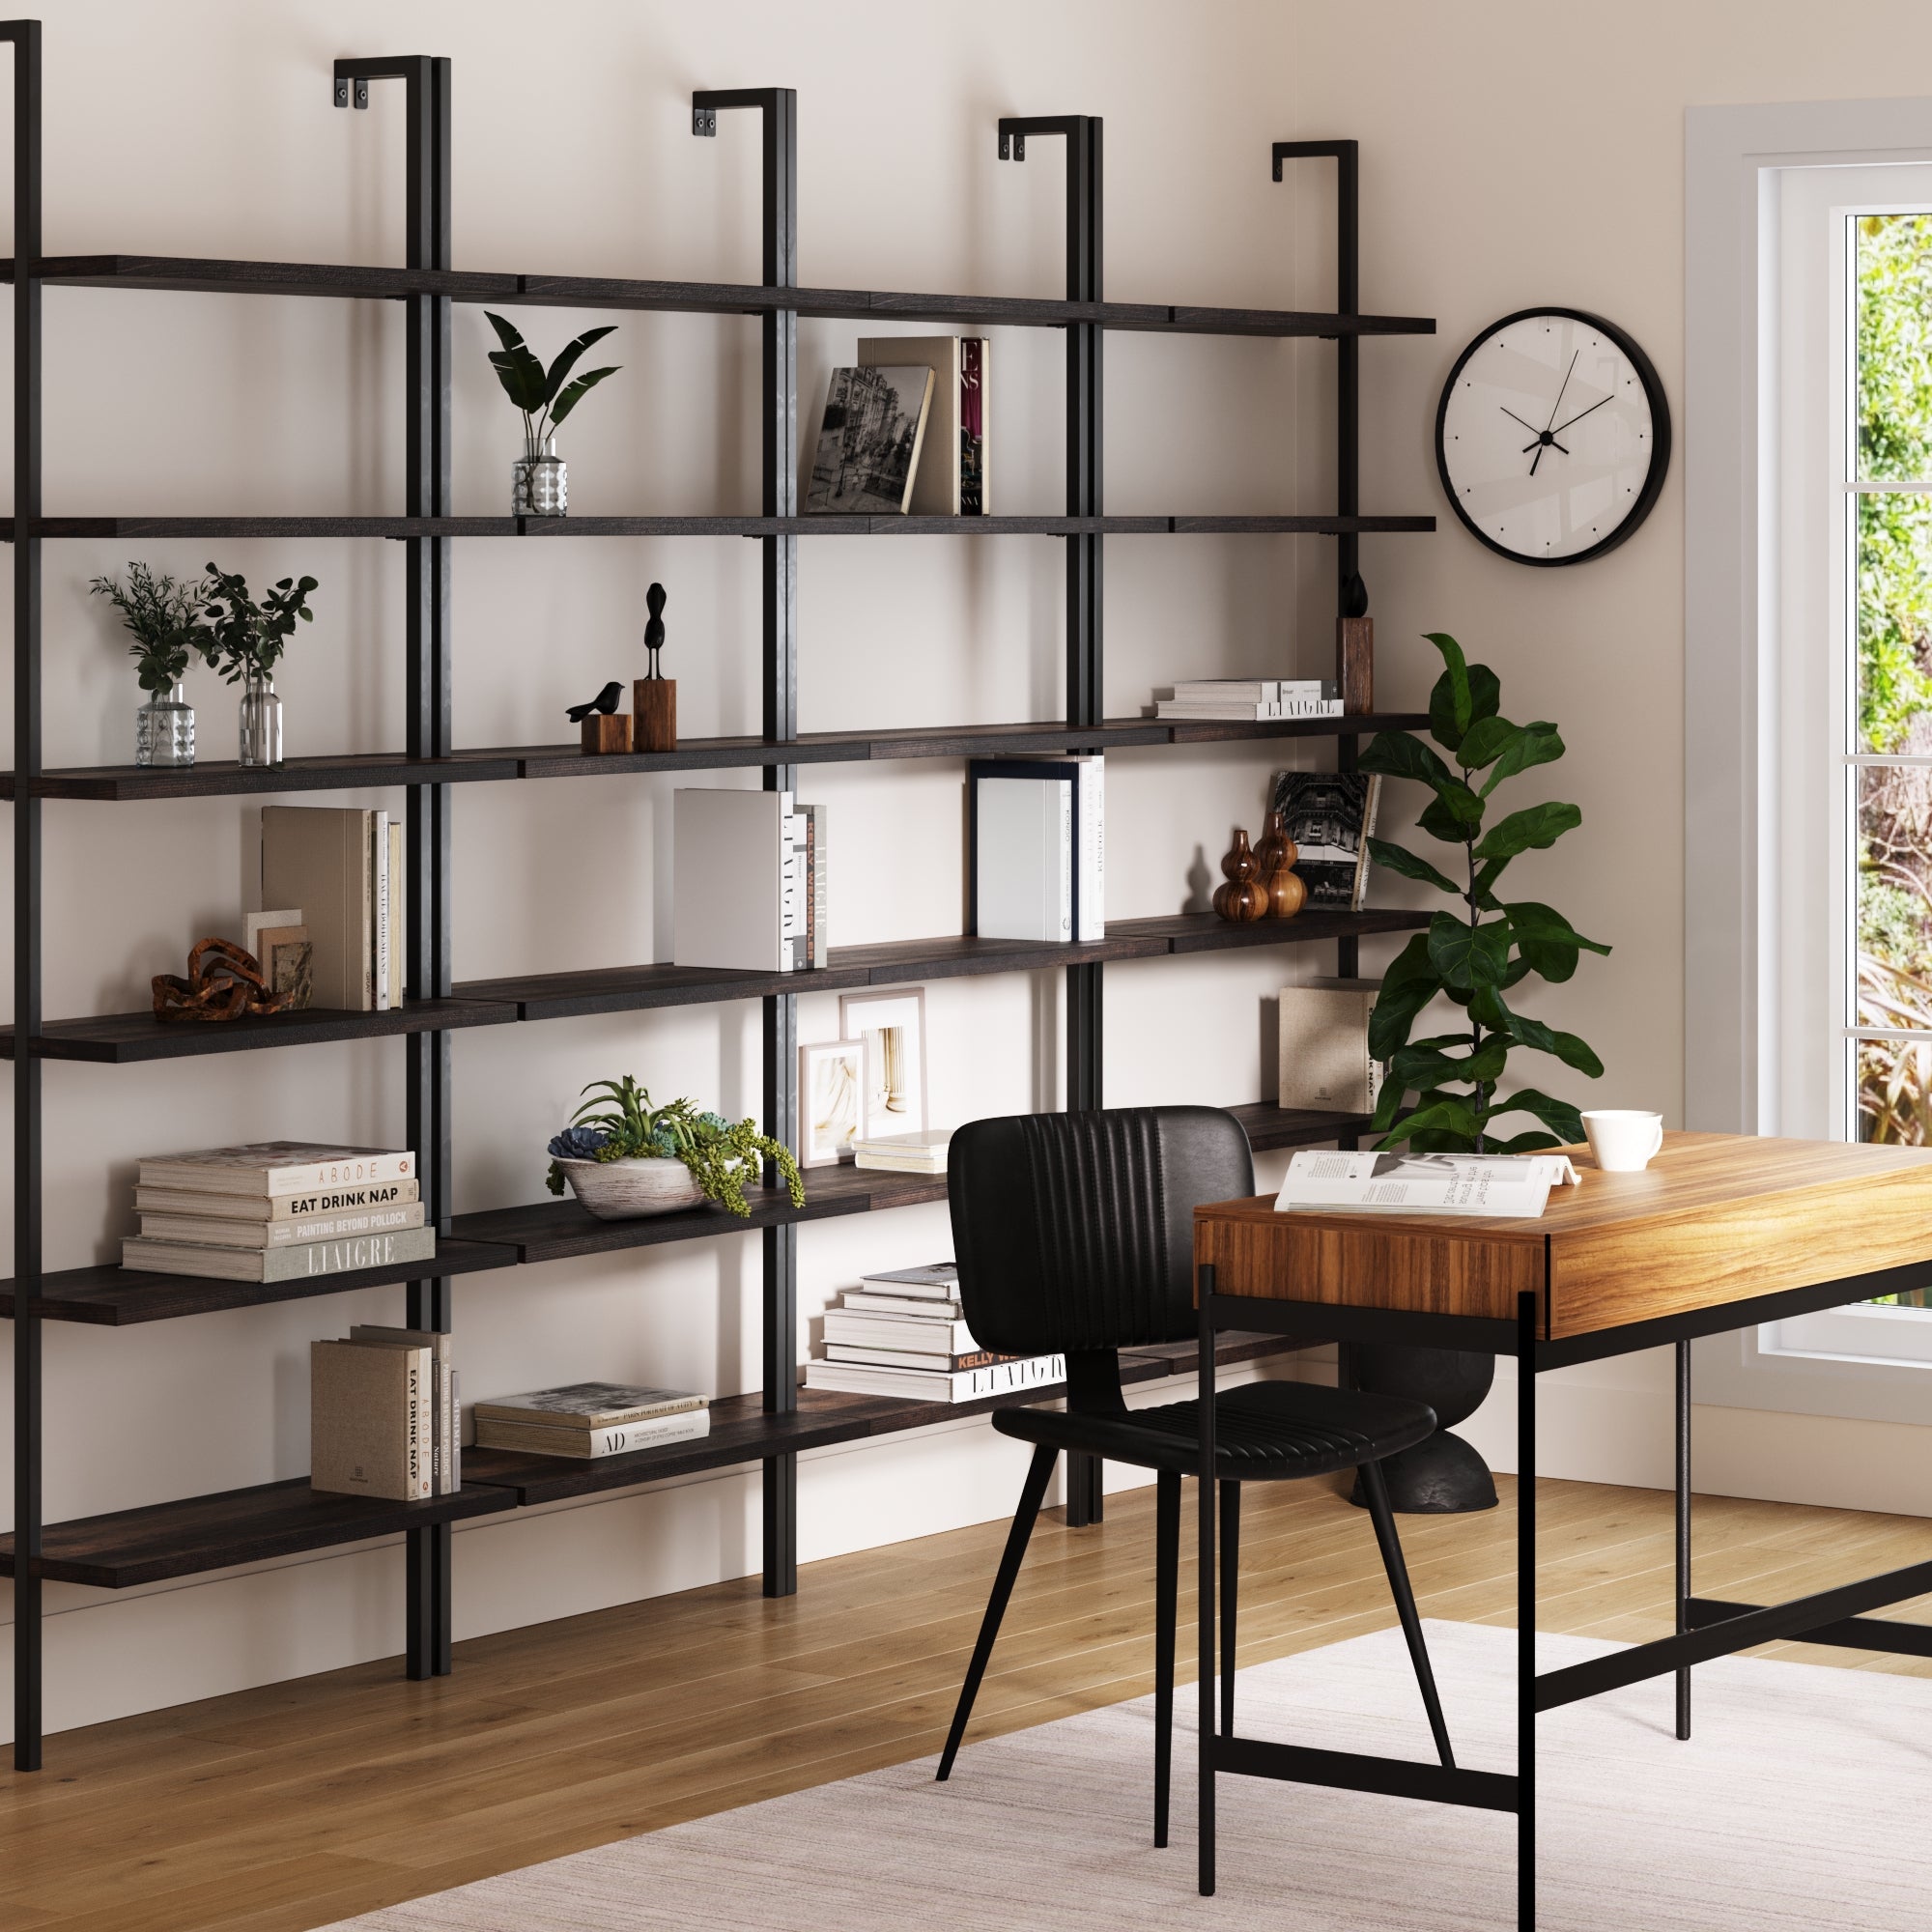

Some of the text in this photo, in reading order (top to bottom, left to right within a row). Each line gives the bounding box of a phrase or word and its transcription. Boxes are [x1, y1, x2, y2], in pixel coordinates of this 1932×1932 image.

[815, 846, 826, 928] LIAIGRE
[319, 1162, 377, 1183] ABODE
[291, 1198, 317, 1213] EAT
[322, 1191, 365, 1209] DRINK
[369, 1187, 398, 1204] NAP
[297, 1222, 334, 1237] PAINTING
[336, 1217, 368, 1233] BEYOND
[370, 1211, 407, 1227] POLLOCK
[308, 1236, 394, 1274] LIAIGRE
[958, 1352, 994, 1369] KELLY
[602, 1433, 625, 1454] AD
